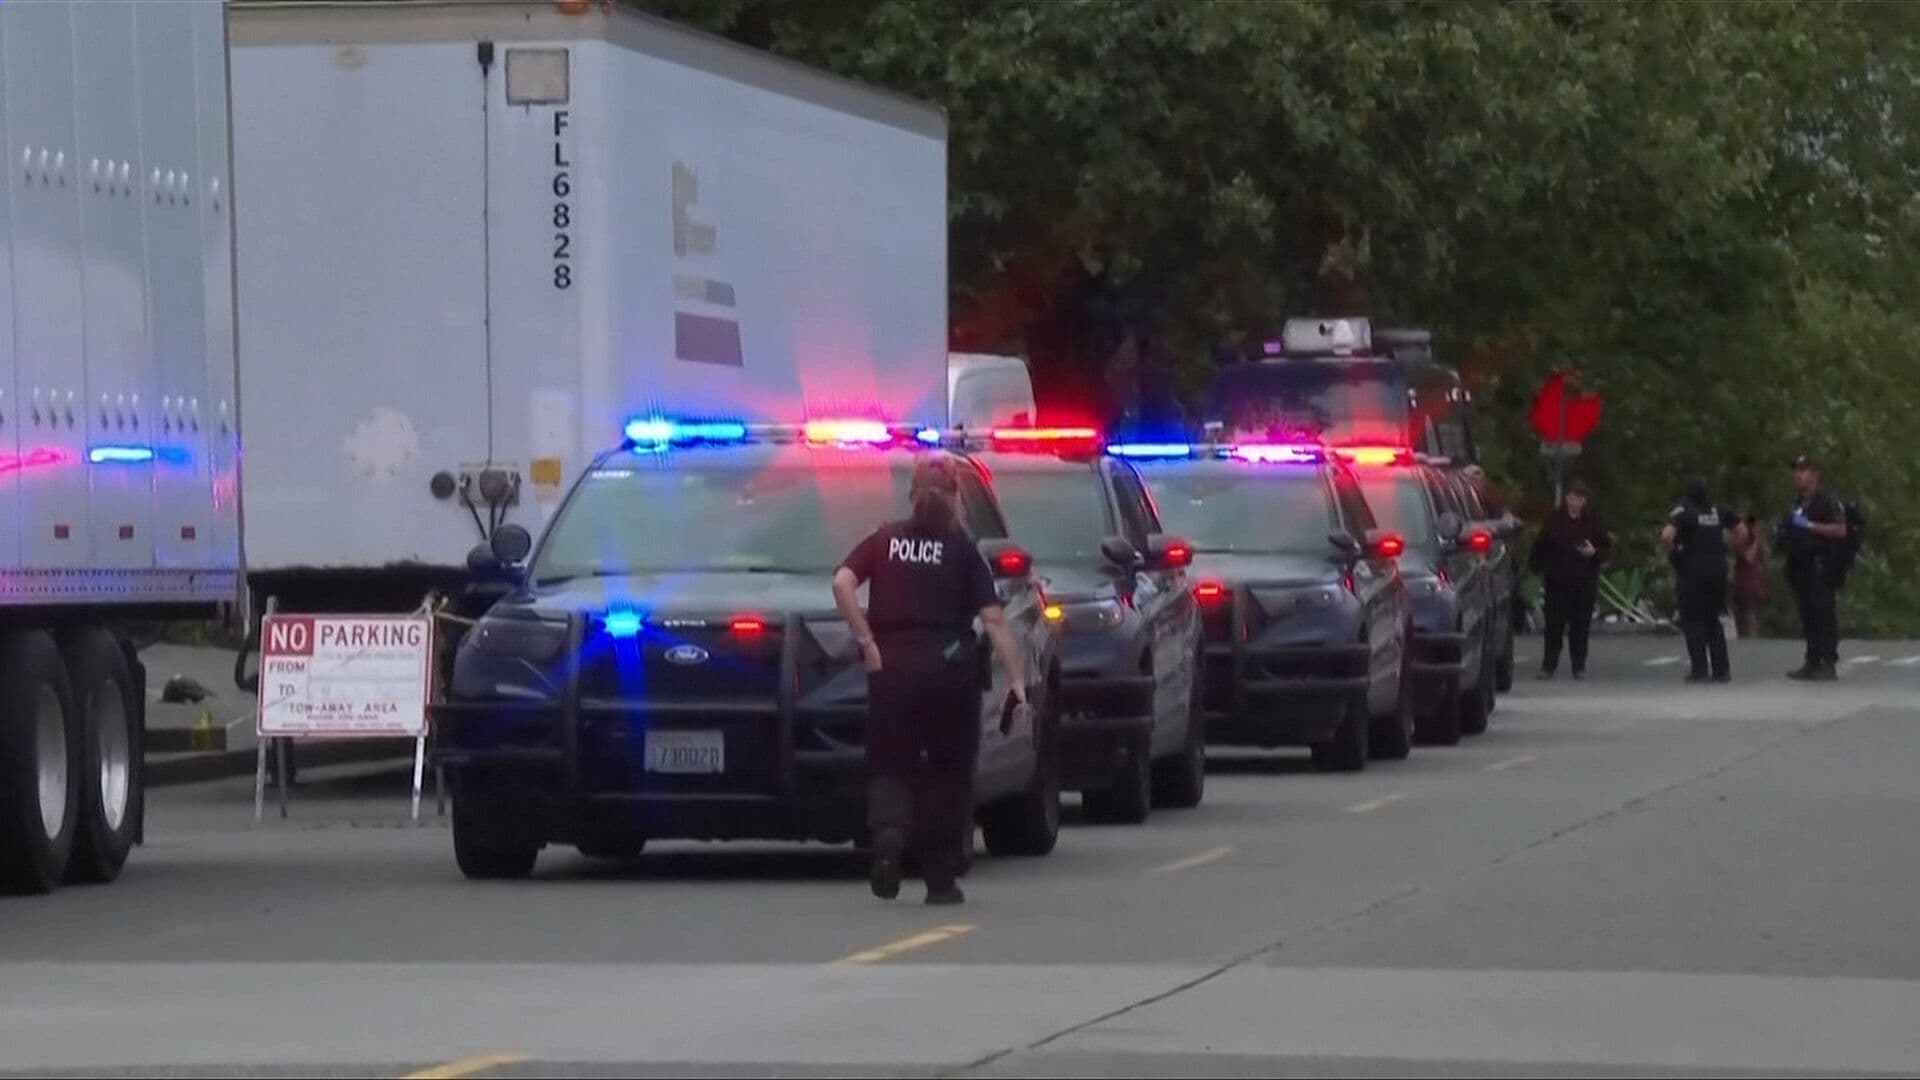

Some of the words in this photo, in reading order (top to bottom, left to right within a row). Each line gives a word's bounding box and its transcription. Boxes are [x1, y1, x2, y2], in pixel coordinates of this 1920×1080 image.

[553, 110, 571, 290] FL6828
[888, 537, 944, 565] POLICE
[270, 623, 307, 651] NO
[320, 624, 421, 647] PARKING
[269, 662, 306, 673] FROM
[279, 684, 296, 697] TO
[289, 703, 352, 714] TOW-AWAY
[364, 703, 398, 713] AREA
